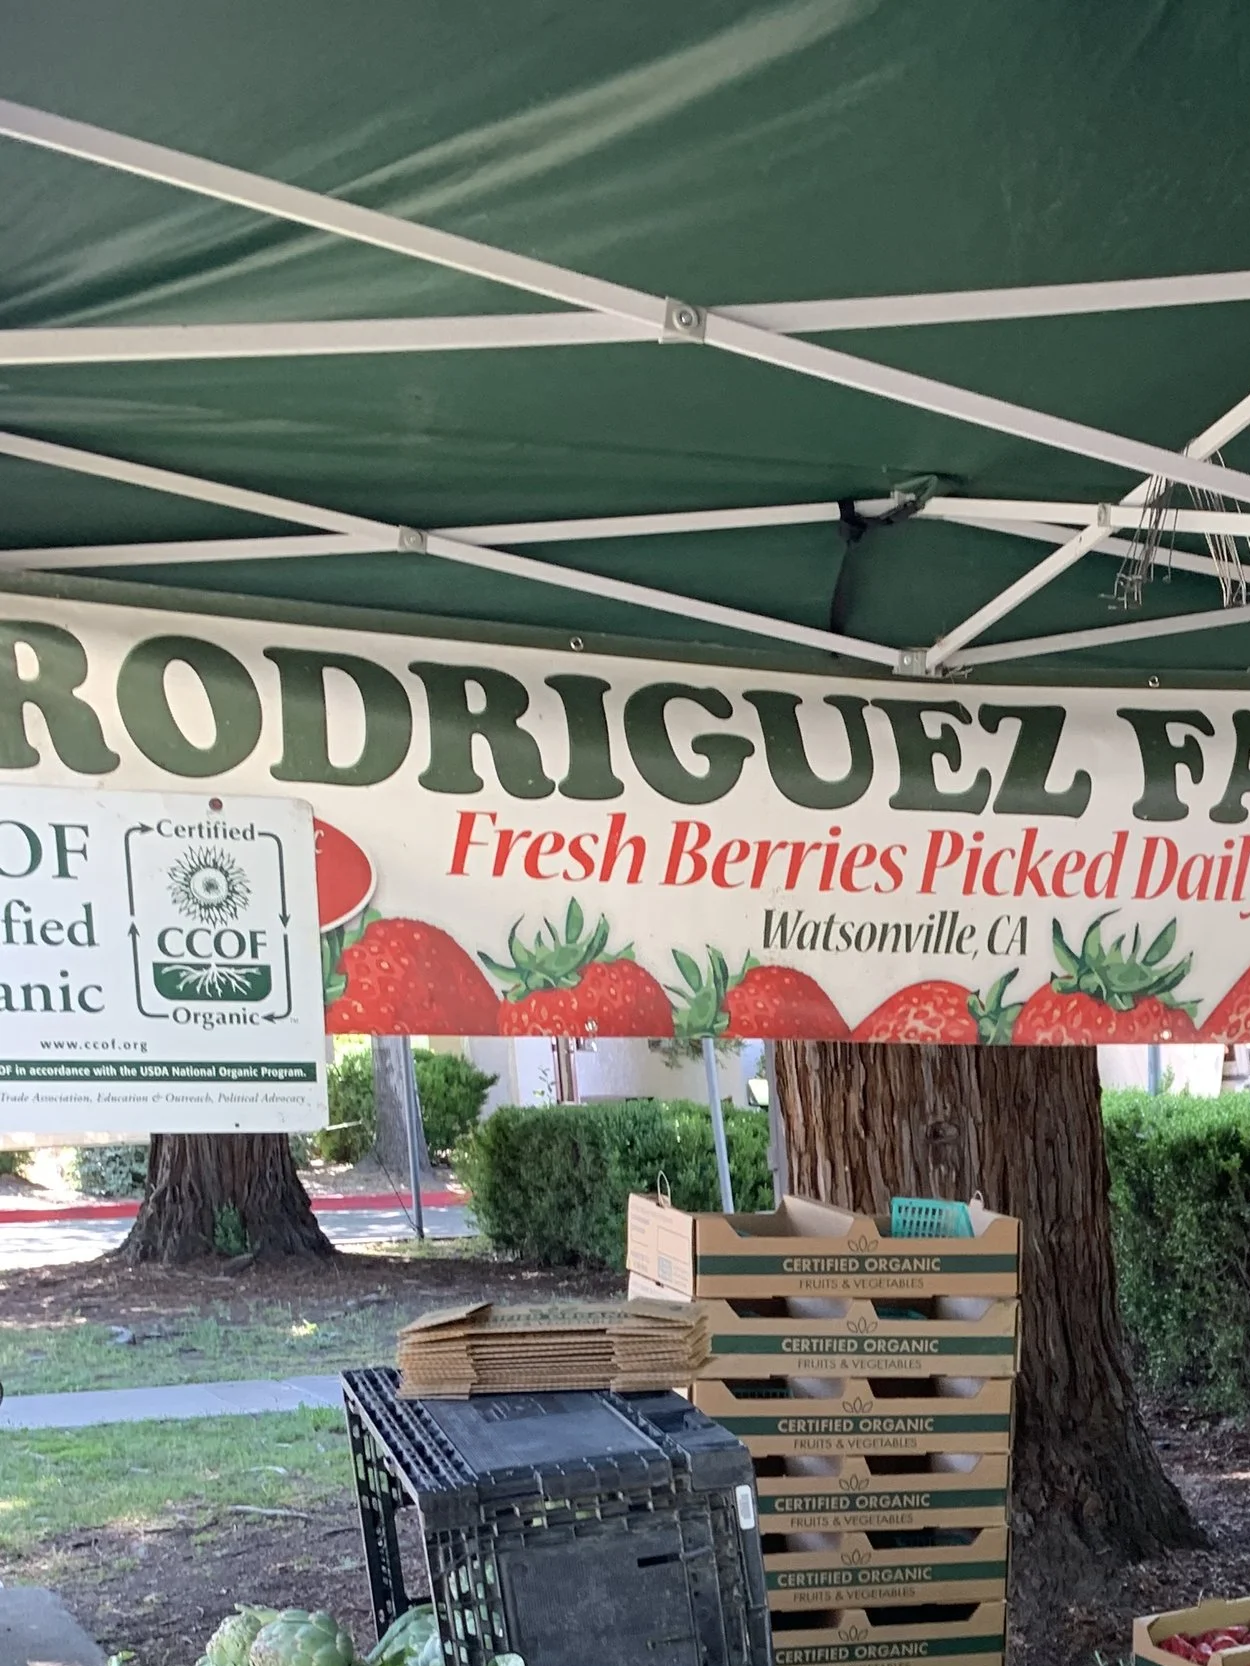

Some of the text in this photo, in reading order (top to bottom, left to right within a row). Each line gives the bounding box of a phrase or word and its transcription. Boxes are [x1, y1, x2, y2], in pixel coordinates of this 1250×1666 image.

[0, 620, 1092, 818] RODRIGUEZ
[156, 818, 256, 841] Certified
[446, 810, 646, 885] Fresh
[659, 820, 907, 894] Berries
[917, 828, 1129, 899] Picked
[157, 927, 267, 959] CCOF
[762, 909, 1028, 960] Watsonville, CA
[172, 1006, 261, 1030] Organic
[40, 1038, 148, 1053] www.ccof.org
[15, 1064, 26, 1076] in
[29, 1064, 91, 1077] accordance
[92, 1064, 117, 1077] with
[120, 1064, 138, 1077] the
[140, 1065, 169, 1077] USDA
[172, 1065, 216, 1077] National
[219, 1066, 258, 1079] Organic
[261, 1067, 307, 1080] Program.
[783, 1258, 941, 1272] CERTIFIED ORGANIC
[781, 1339, 939, 1353] CERTIFIED ORGANIC
[777, 1418, 934, 1433] CERTIFIED ORGANIC
[774, 1494, 930, 1512] CERTIFIED ORGANIC
[777, 1567, 932, 1587] CERTIFIED ORGANIC
[775, 1643, 929, 1664] CERTIFIED ORGANIC
